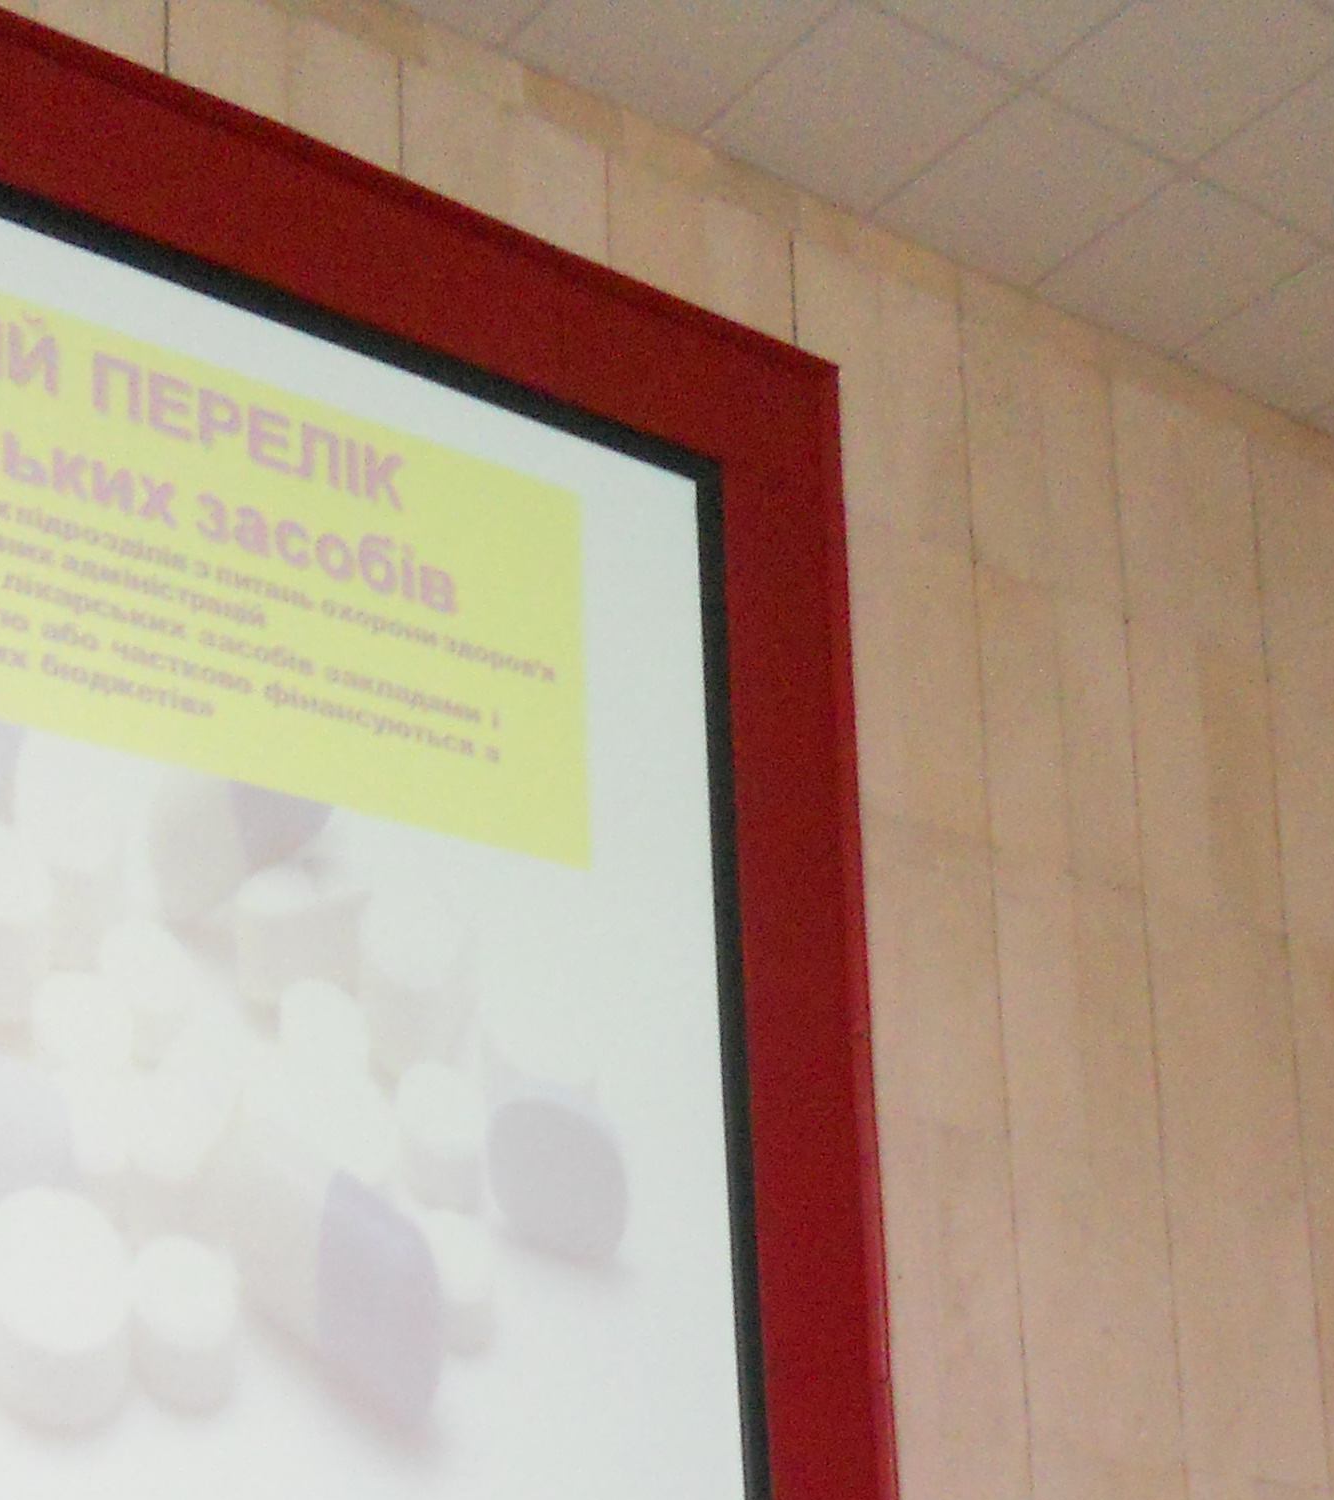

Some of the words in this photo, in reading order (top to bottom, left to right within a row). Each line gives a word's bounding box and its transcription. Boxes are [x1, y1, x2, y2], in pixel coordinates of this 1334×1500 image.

[90, 350, 404, 511] ПЕРЕЛІК
[14, 505, 187, 572] підрозділів
[192, 558, 210, 580] з
[215, 564, 314, 611] питань
[320, 598, 439, 647] охорони
[195, 491, 459, 615] засобів
[1, 572, 186, 639] лікарських
[198, 628, 315, 677] засобів
[324, 664, 481, 724] закладами
[40, 621, 100, 652] або
[111, 639, 253, 695] частково
[264, 679, 475, 756] фінансуються
